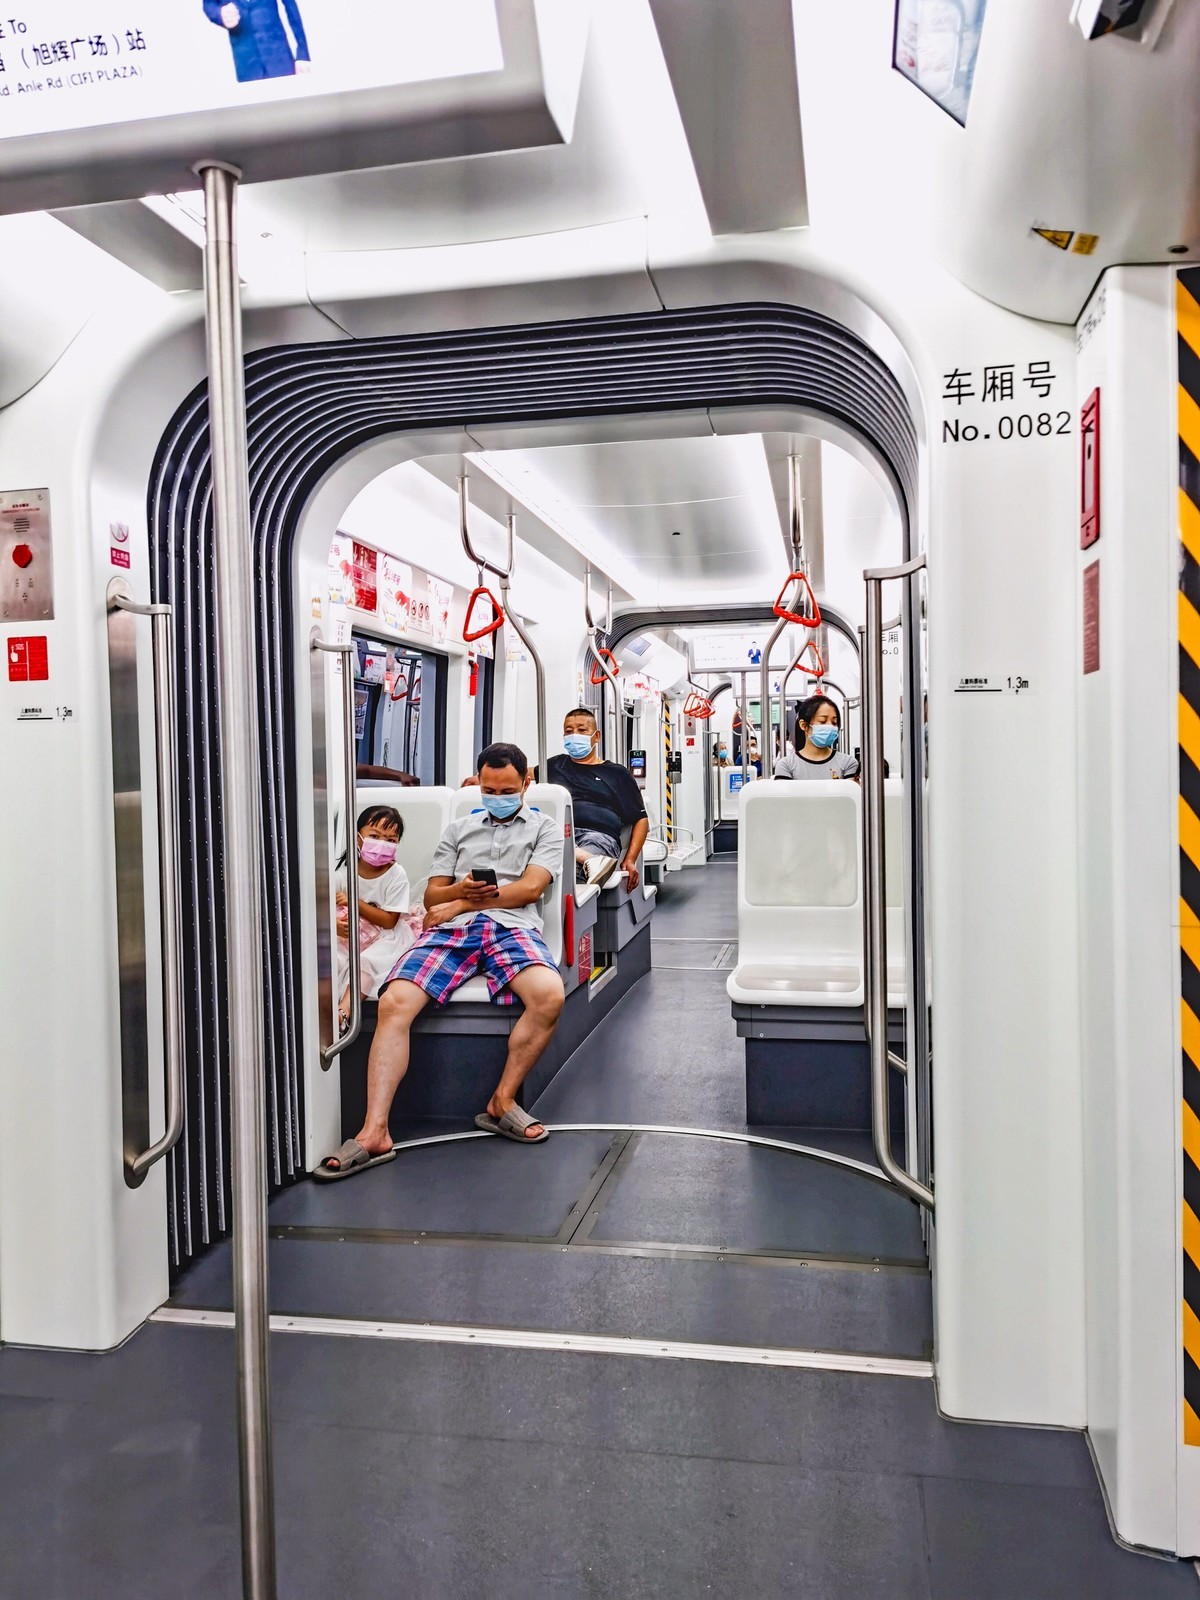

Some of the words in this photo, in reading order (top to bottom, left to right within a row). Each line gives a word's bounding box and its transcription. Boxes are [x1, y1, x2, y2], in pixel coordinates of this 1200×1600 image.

[8, 19, 27, 34] To
[0, 28, 146, 72] （旭辉广场）站
[17, 80, 43, 94] Anle
[46, 76, 63, 89] Rd
[97, 65, 142, 81] PLAZA)
[942, 360, 1056, 405] 车厢号
[942, 411, 1071, 443] No.0082
[881, 646, 899, 655] o.0
[1007, 676, 1029, 689] 1.3m
[56, 706, 73, 718] 1.3m
